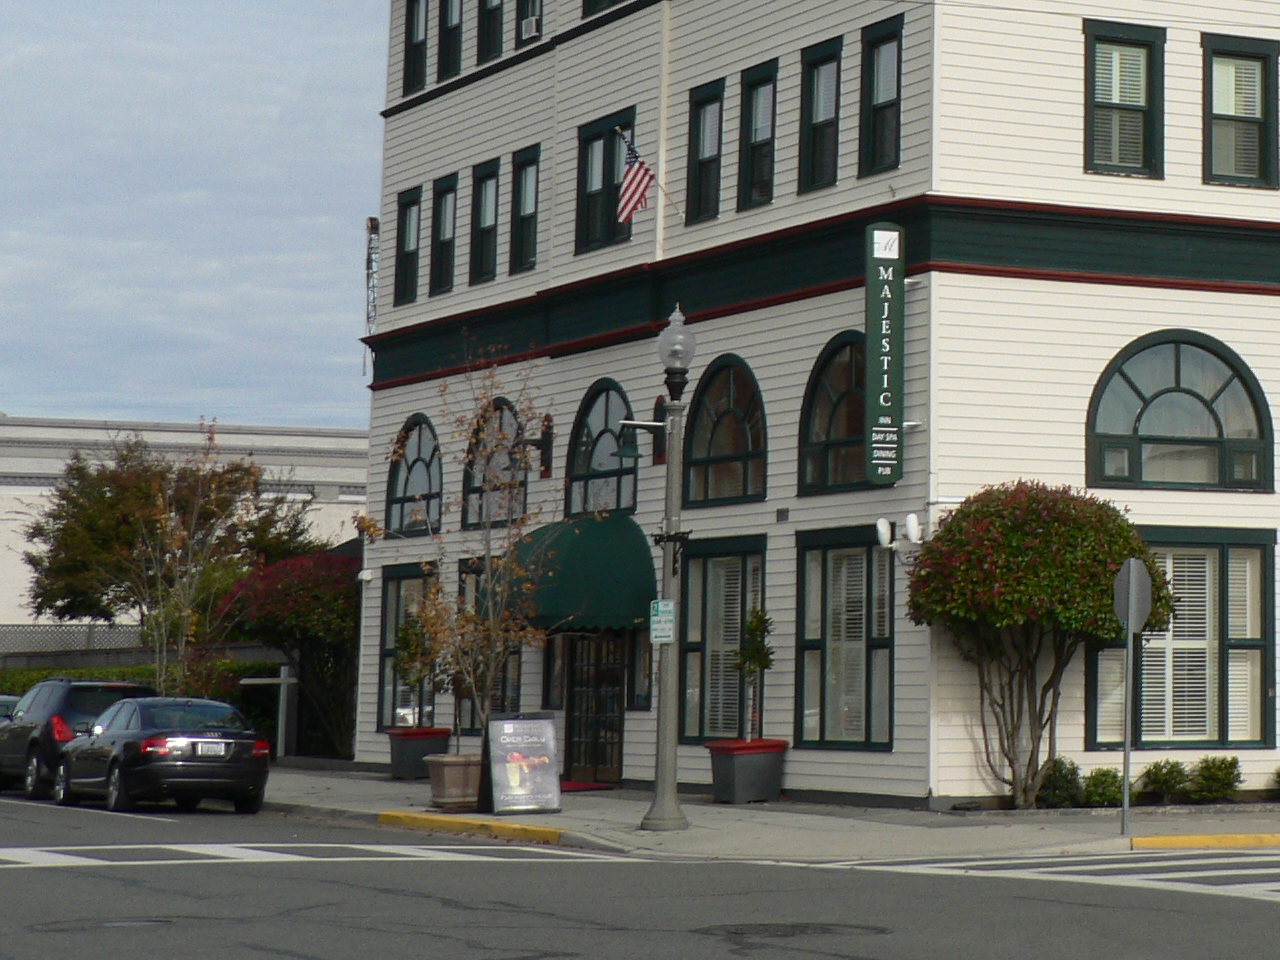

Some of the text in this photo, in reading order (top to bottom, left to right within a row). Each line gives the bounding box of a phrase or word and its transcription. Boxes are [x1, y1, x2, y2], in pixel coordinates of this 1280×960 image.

[879, 266, 894, 406] MAJESTIC
[872, 433, 885, 441] DAY
[873, 449, 896, 458] DINING
